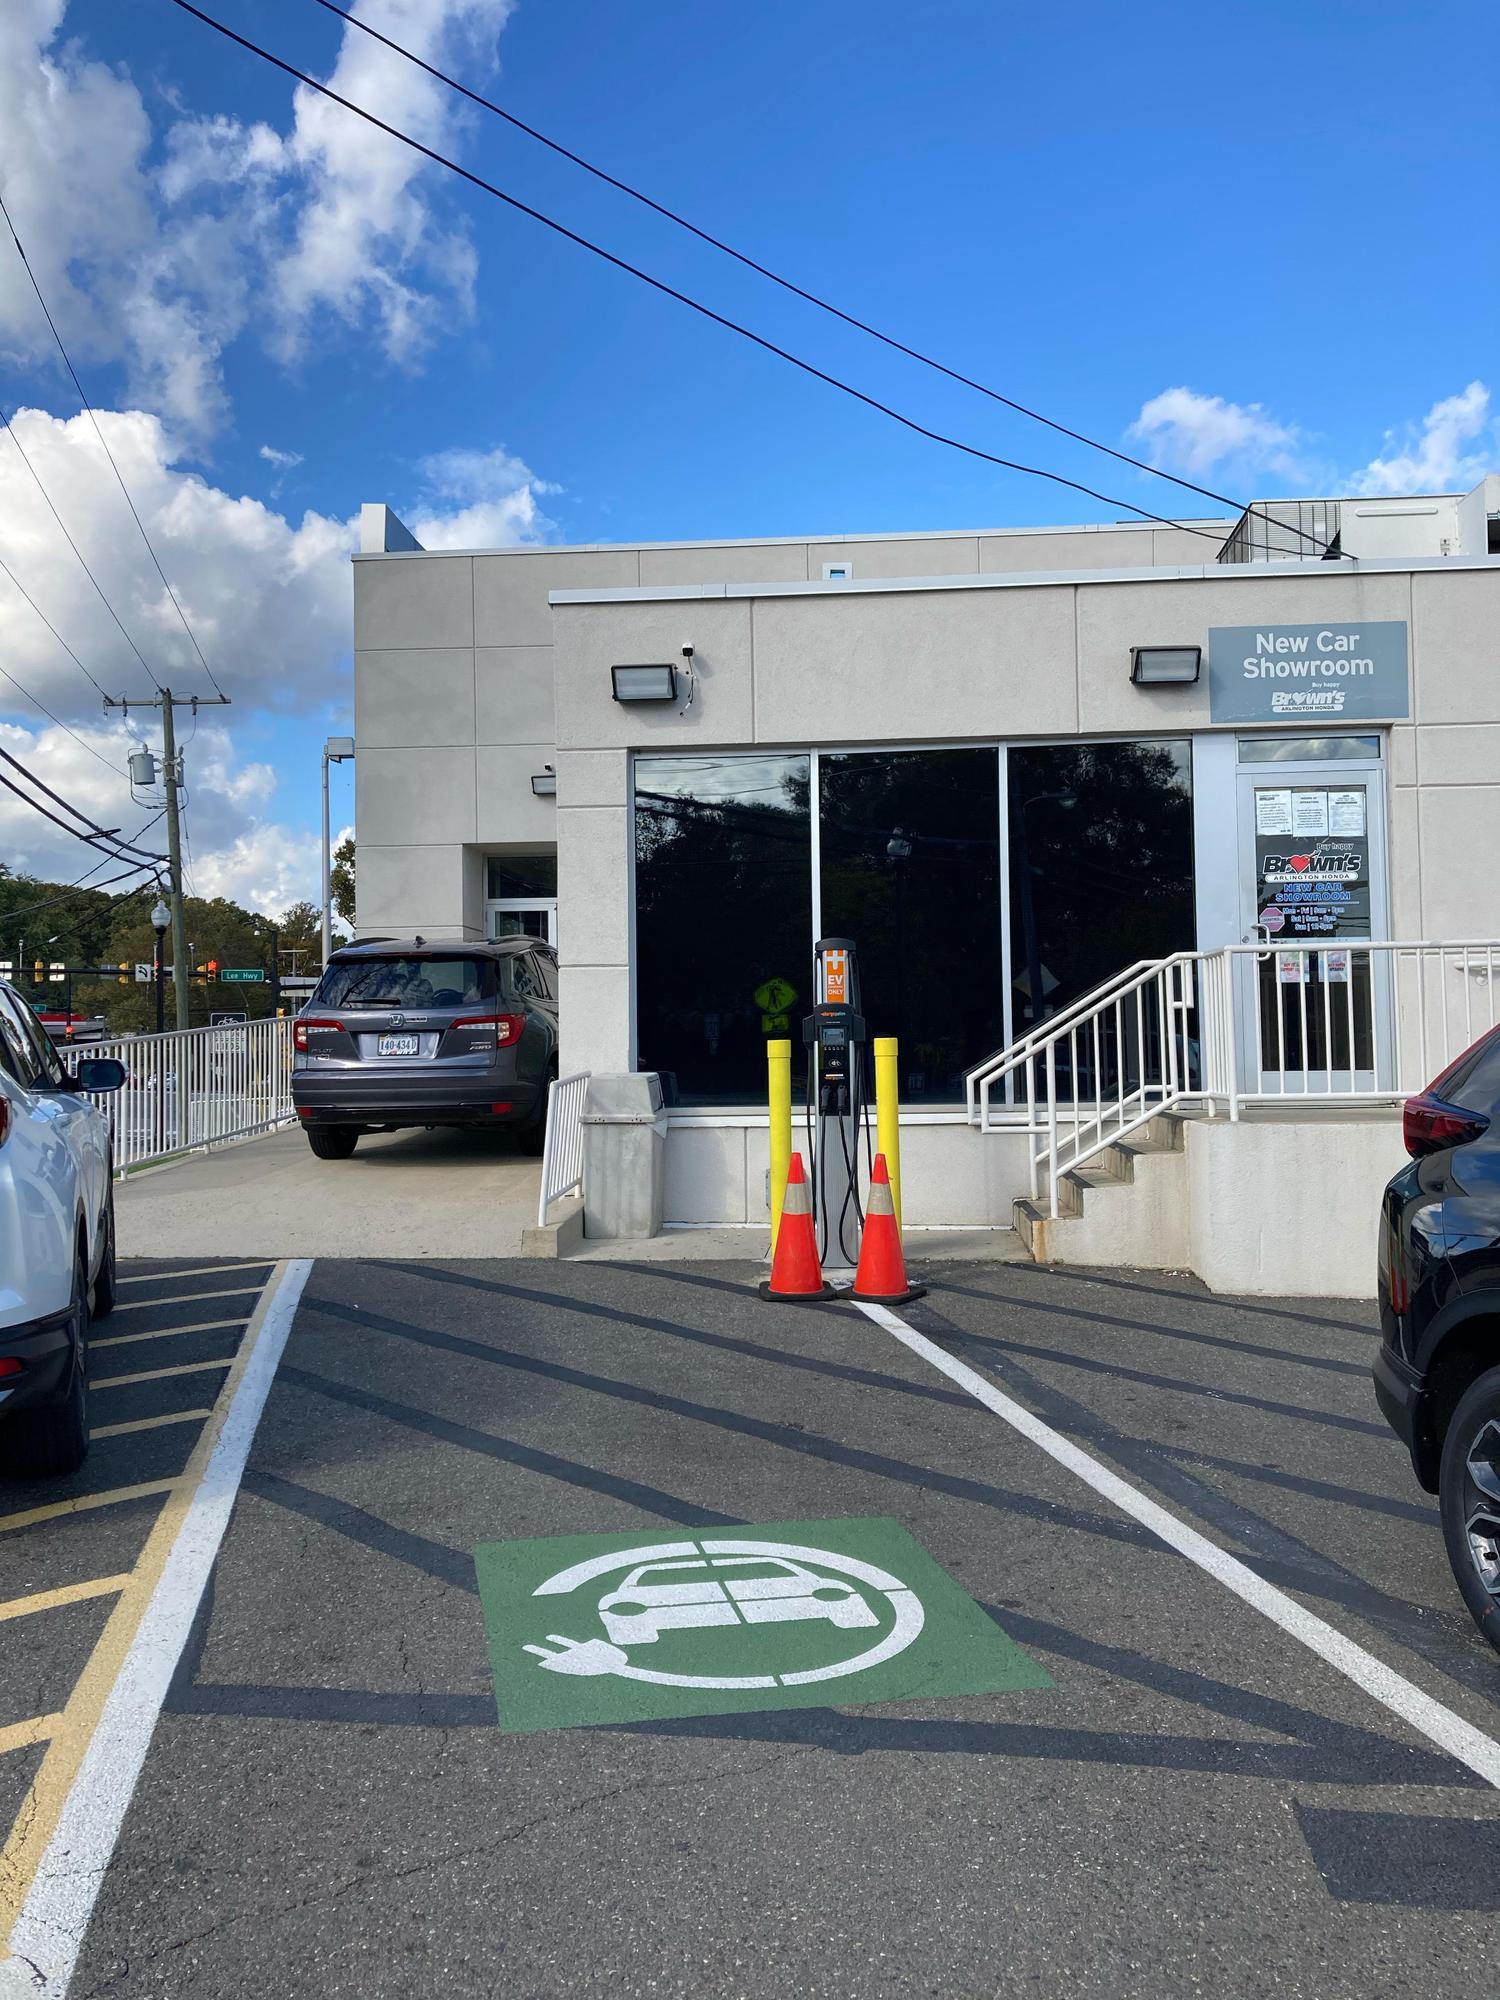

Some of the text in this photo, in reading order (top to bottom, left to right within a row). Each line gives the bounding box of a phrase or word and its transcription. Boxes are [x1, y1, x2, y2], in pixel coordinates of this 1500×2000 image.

[1256, 630, 1360, 654] New Car
[1242, 657, 1374, 679] Showroom
[1316, 842, 1354, 851] Buy happy
[1283, 882, 1344, 893] NEW CAR
[1275, 891, 1351, 902] SHOWROOM
[243, 972, 258, 980] Hwy
[827, 974, 843, 985] EV
